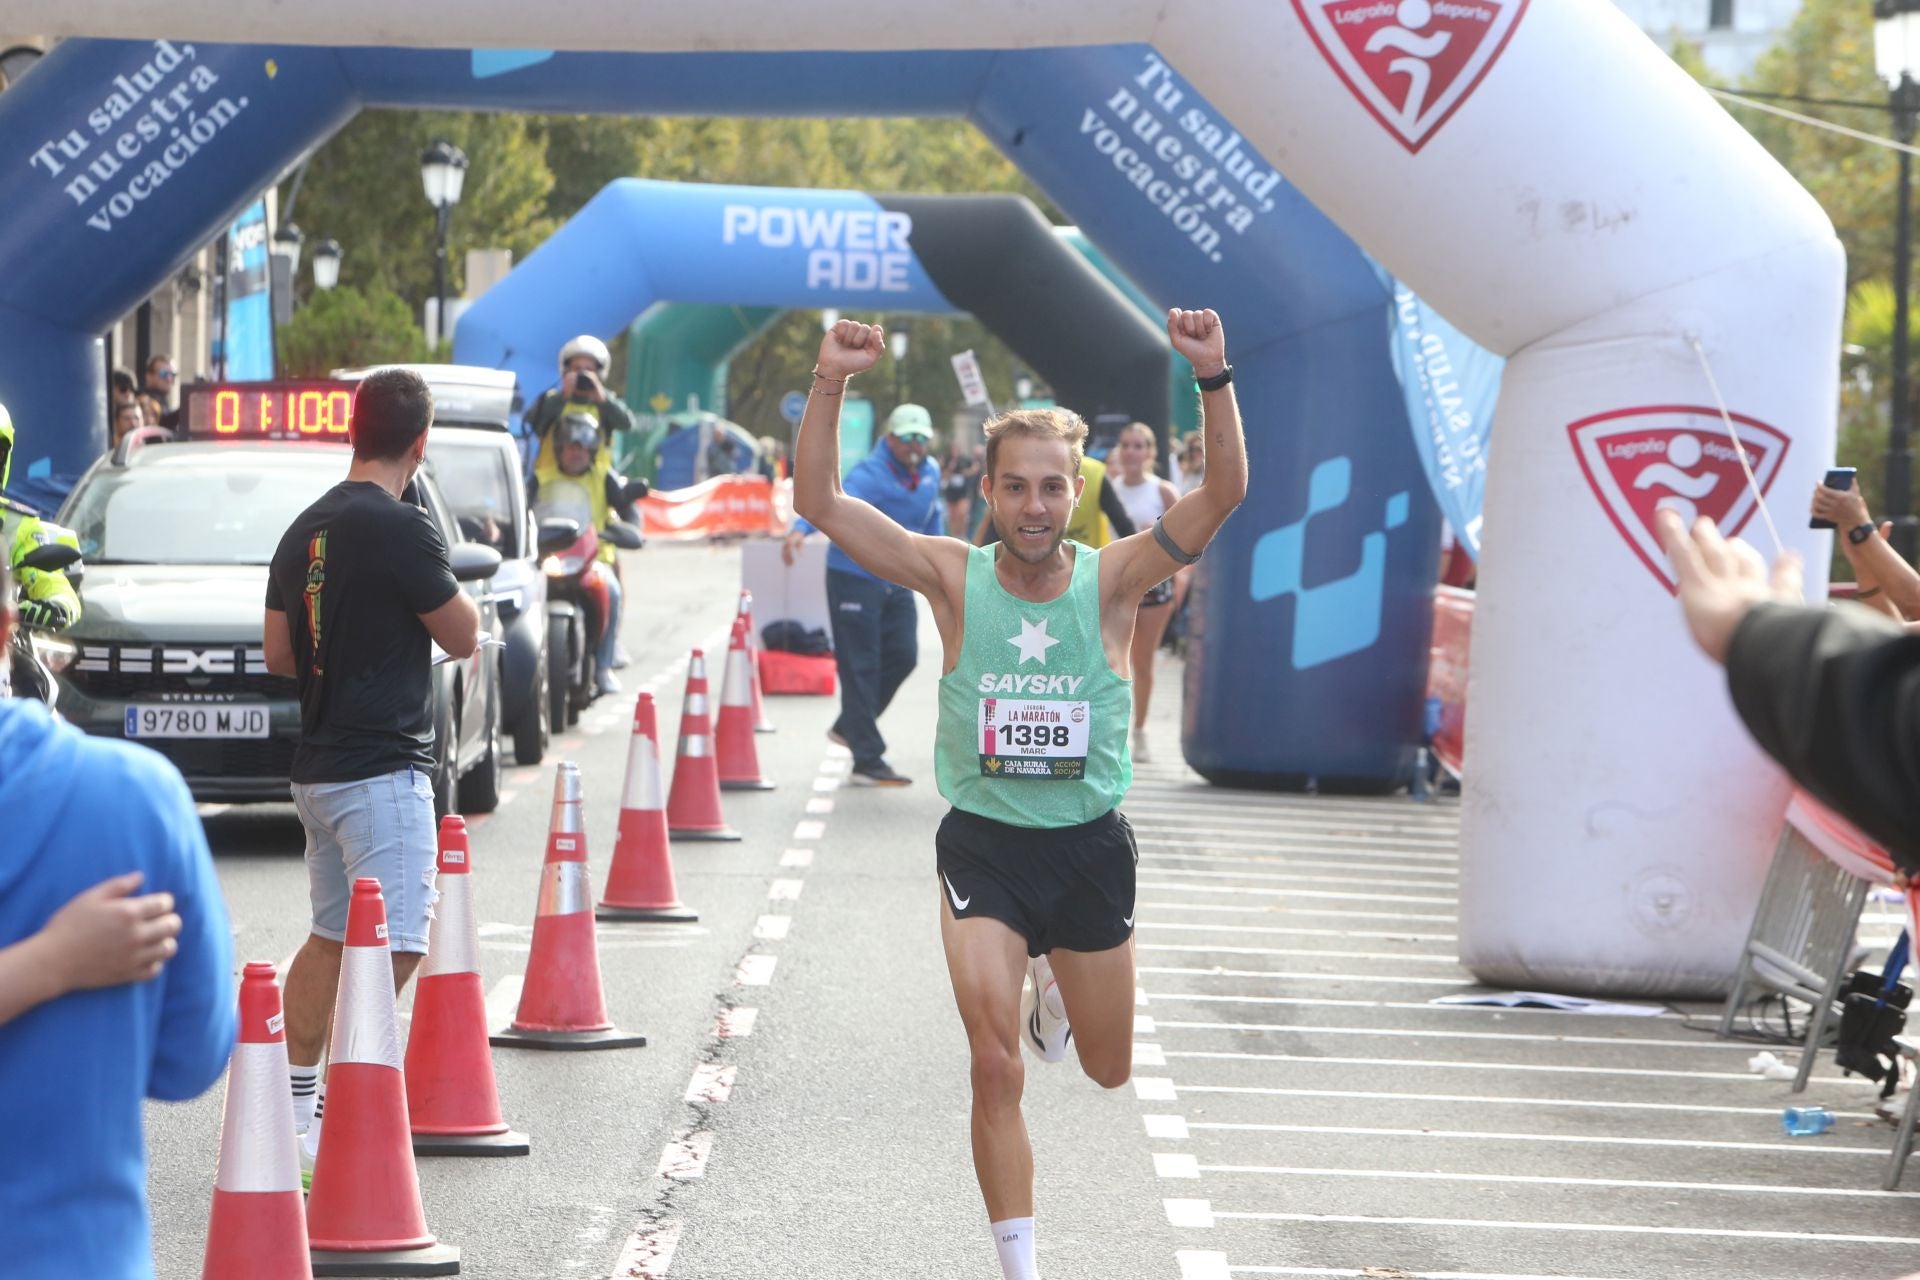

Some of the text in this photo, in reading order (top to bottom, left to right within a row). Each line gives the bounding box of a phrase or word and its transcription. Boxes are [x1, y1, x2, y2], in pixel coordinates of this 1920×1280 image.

[1334, 1, 1492, 25] Logroño deporte
[30, 39, 197, 178] Tu salud,
[64, 63, 219, 206] nuestra
[1134, 53, 1282, 214] Tu salud,
[86, 96, 249, 233] vocación.
[1106, 87, 1254, 235] nuestra
[1079, 107, 1223, 263] vocación.
[723, 204, 913, 251] POWER
[807, 249, 913, 292] ADE
[215, 390, 350, 433] 01:10:0
[1606, 437, 1667, 459] Logroño
[978, 672, 1084, 695] SAYSKY
[143, 709, 207, 733] 9780
[216, 709, 264, 733] MJD
[1008, 710, 1019, 722] LA
[1021, 709, 1061, 723] MARATÓN
[999, 724, 1070, 747] 1398
[1020, 747, 1047, 755] MARC
[1004, 760, 1049, 769] CAJA RURAL
[1016, 767, 1051, 775] NAVARRA
[1054, 760, 1081, 768] ACCIÓN
